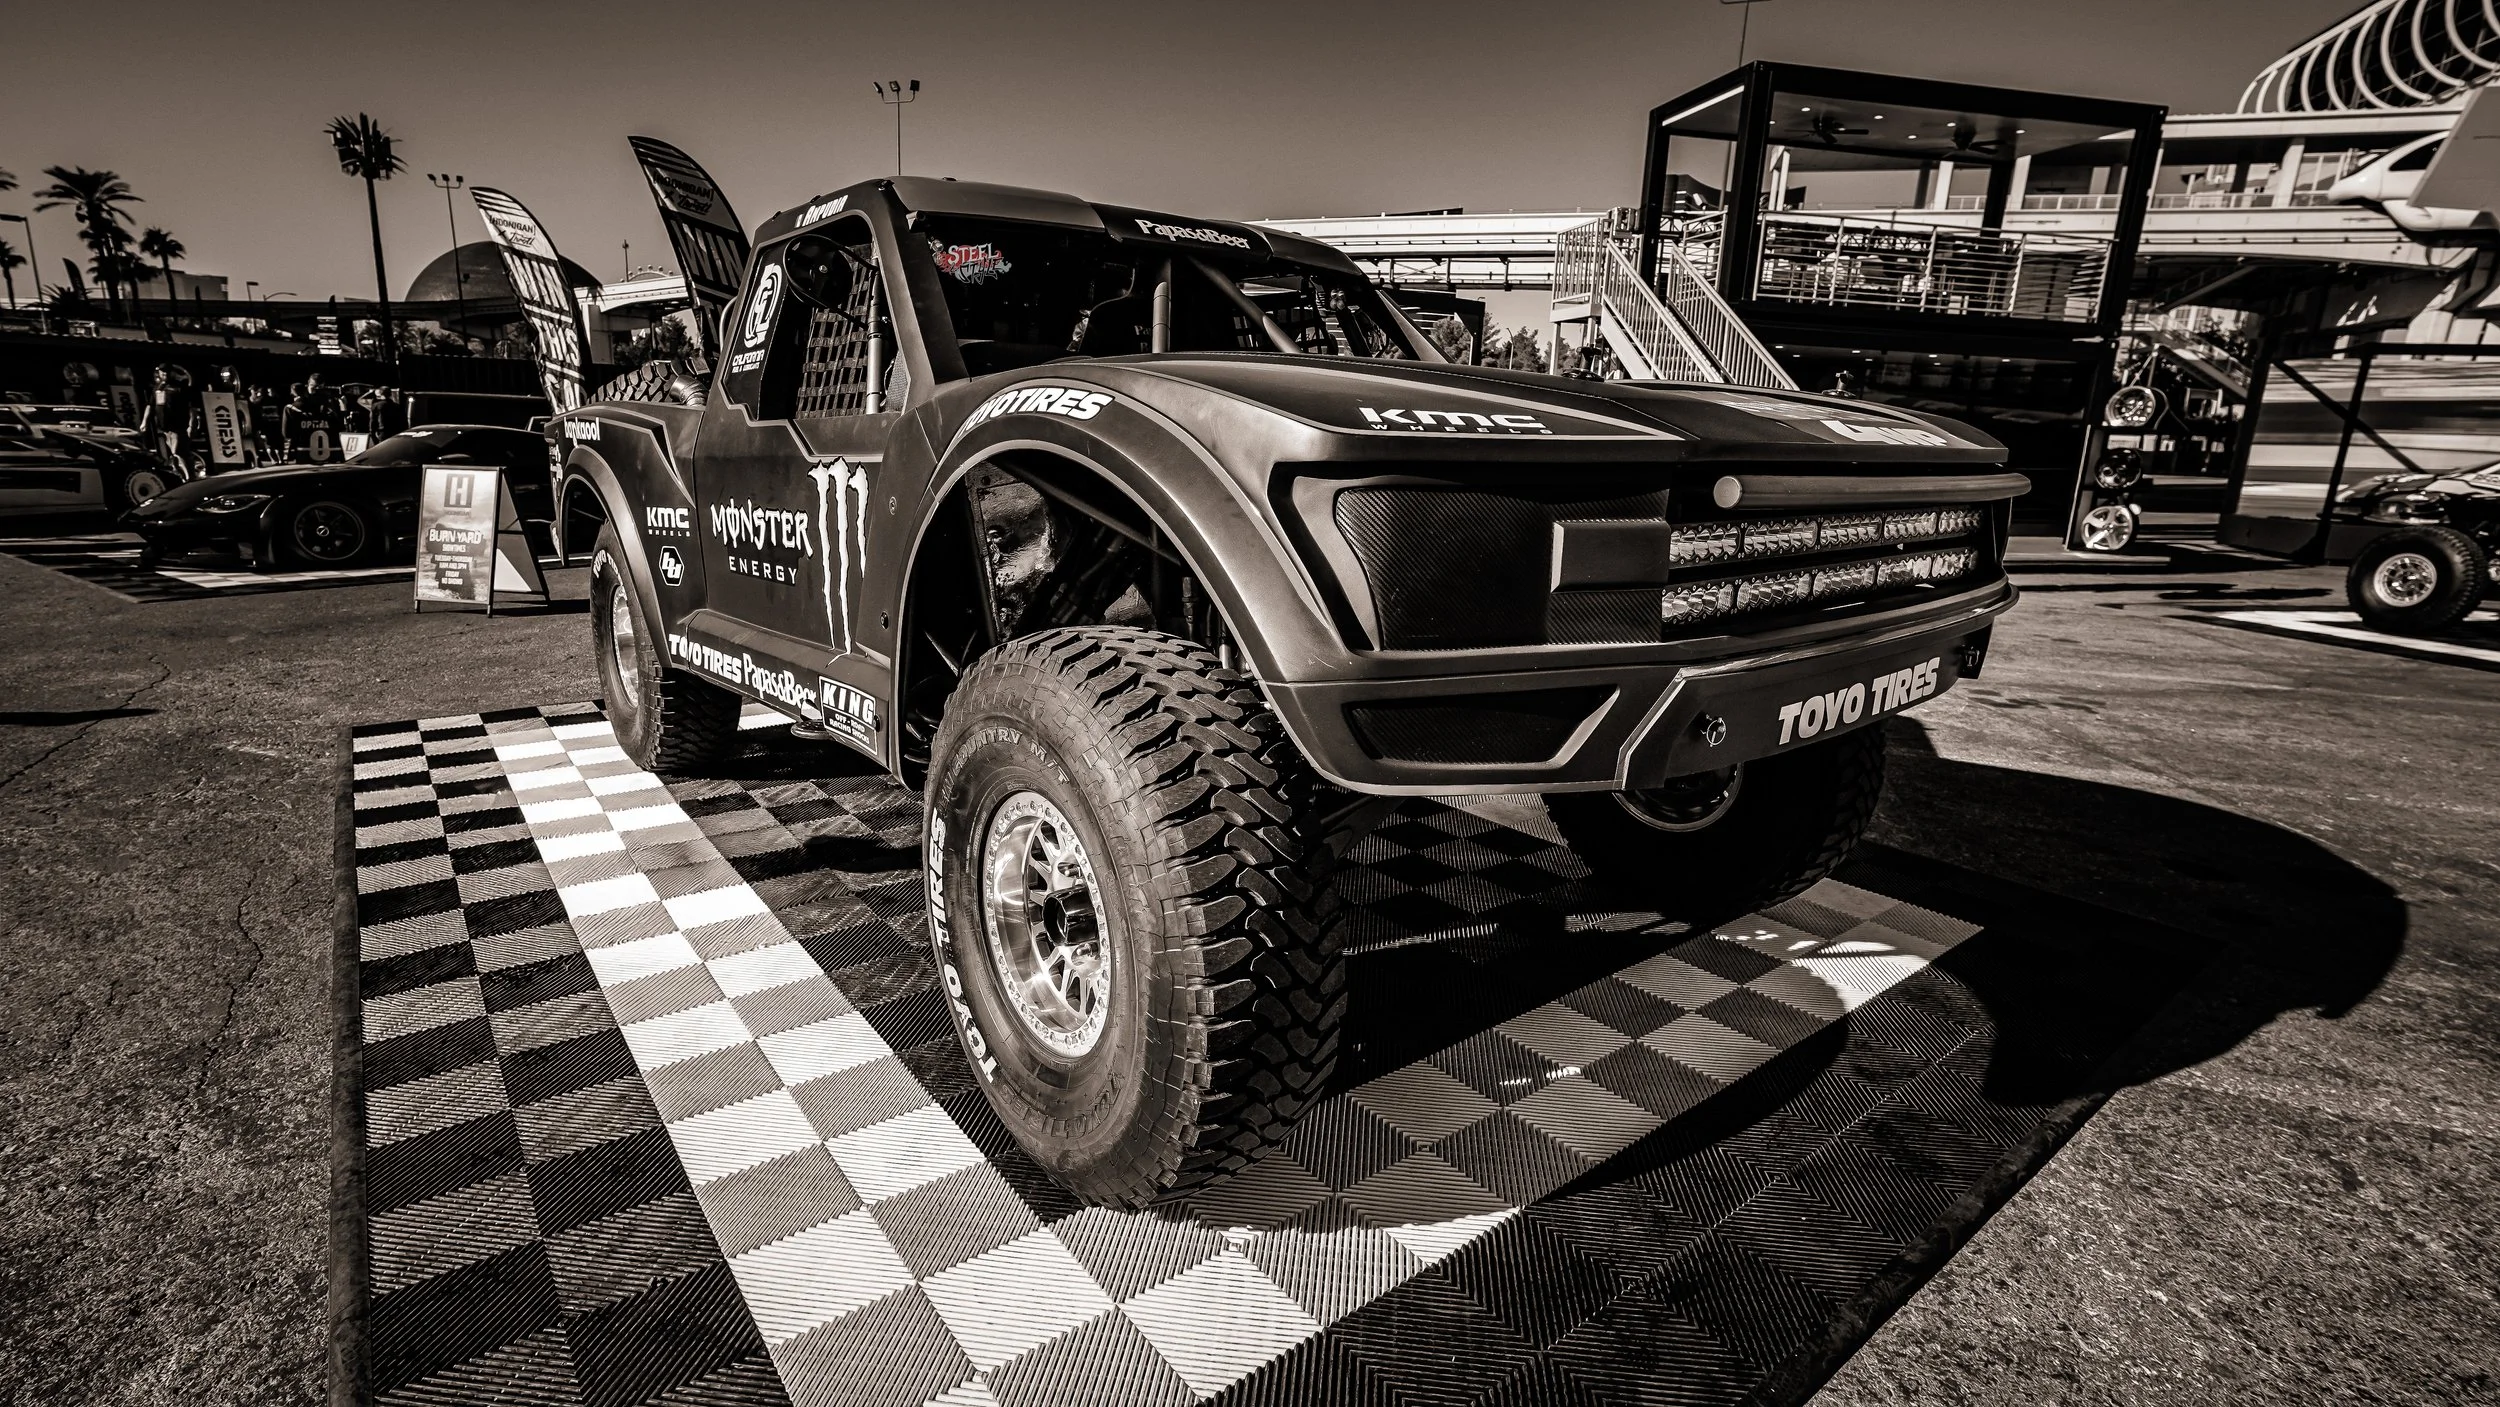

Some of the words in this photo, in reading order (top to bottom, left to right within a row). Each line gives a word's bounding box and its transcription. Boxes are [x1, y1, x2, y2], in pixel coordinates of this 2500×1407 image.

[671, 219, 744, 290] WIN
[947, 242, 999, 265] STEEL
[503, 251, 570, 312] WIN
[531, 316, 581, 368] THIS
[564, 416, 601, 449] bankaool
[1358, 407, 1547, 429] KMC
[1370, 424, 1554, 435] WHEELS
[646, 506, 691, 529] KMC
[647, 528, 692, 538] WHEELS
[428, 528, 456, 543] BURN
[456, 531, 483, 545] YARD
[728, 555, 798, 585] ENERGY
[822, 681, 876, 726] KING
[1778, 682, 1867, 746] TOYO
[1871, 656, 1941, 716] TIRES
[829, 717, 852, 734] RACING
[852, 728, 870, 745] SHOCKS
[928, 808, 951, 949] TIRES
[943, 963, 998, 1084] TOYO
